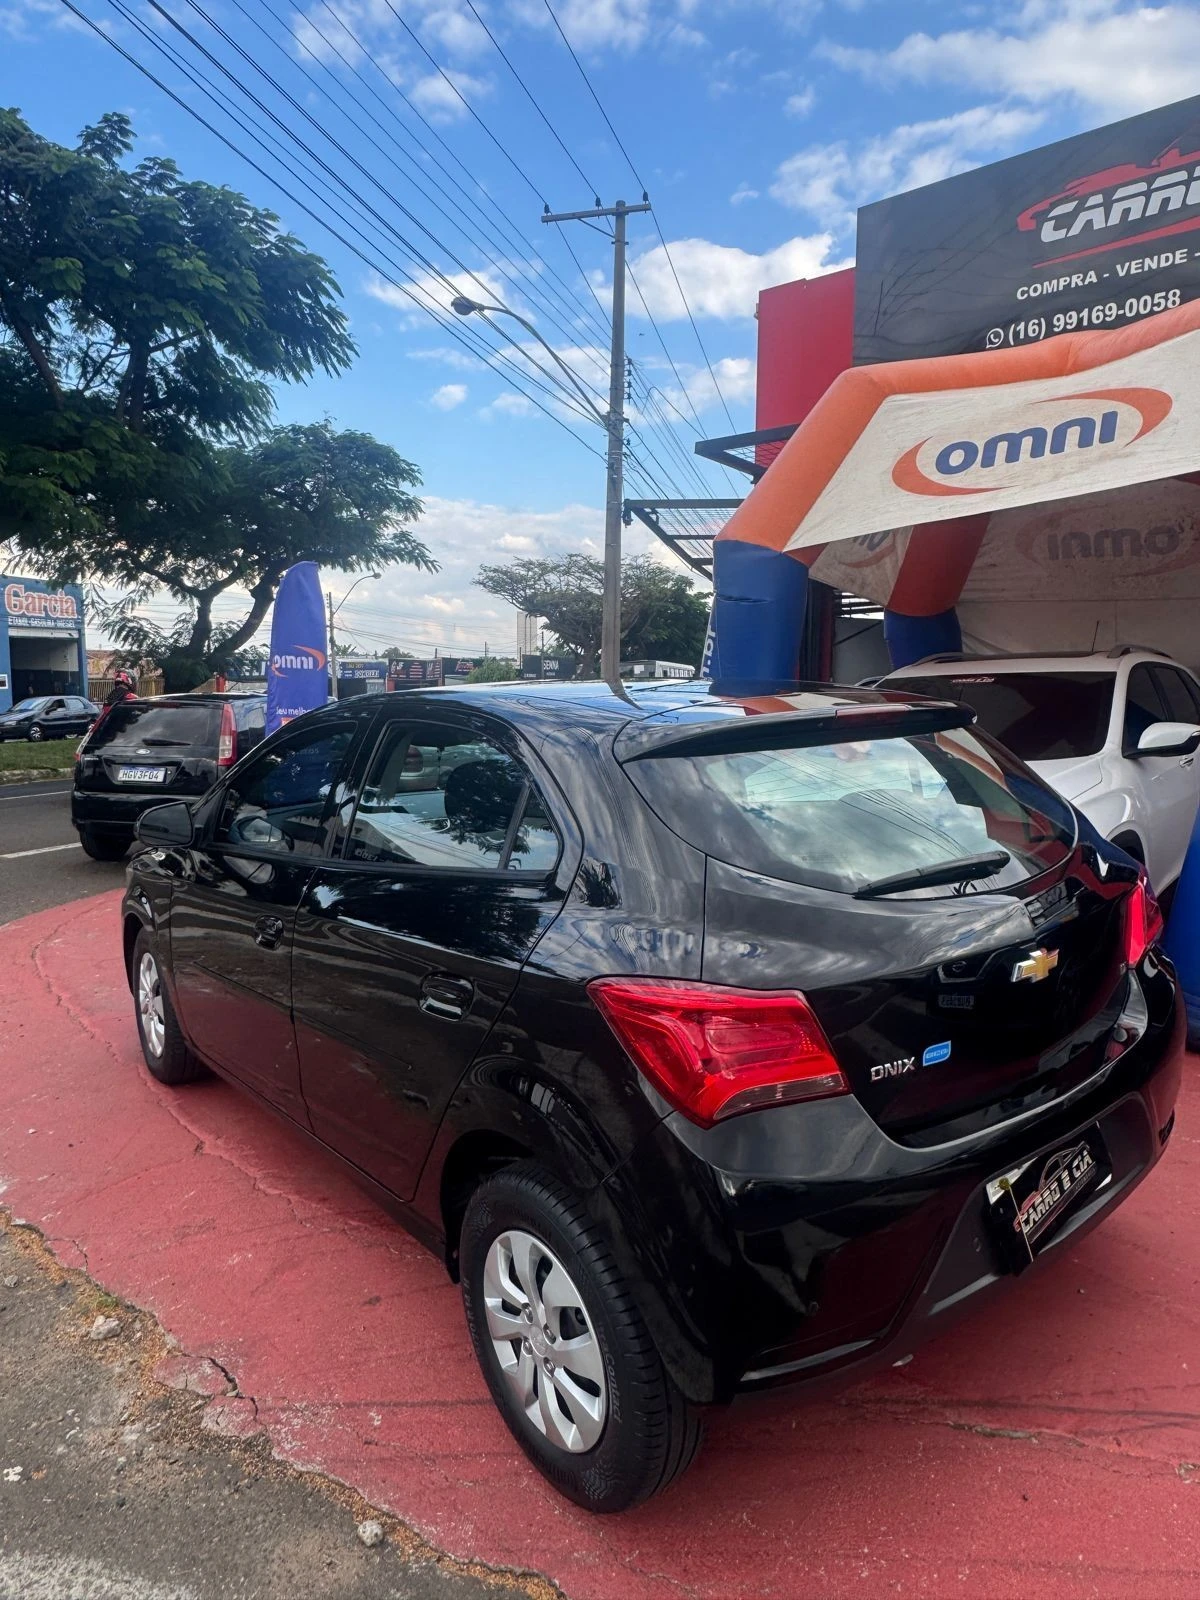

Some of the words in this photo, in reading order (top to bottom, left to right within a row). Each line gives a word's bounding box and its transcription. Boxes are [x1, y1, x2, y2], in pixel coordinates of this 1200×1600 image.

[1016, 270, 1098, 300] COMPRA
[1115, 248, 1189, 277] VENDE
[1008, 317, 1046, 346] (16)
[1053, 288, 1181, 333] 99169-0058
[934, 410, 1119, 476] omni
[4, 583, 78, 619] Garcia
[273, 654, 314, 670] omni
[870, 1056, 916, 1082] ONIX
